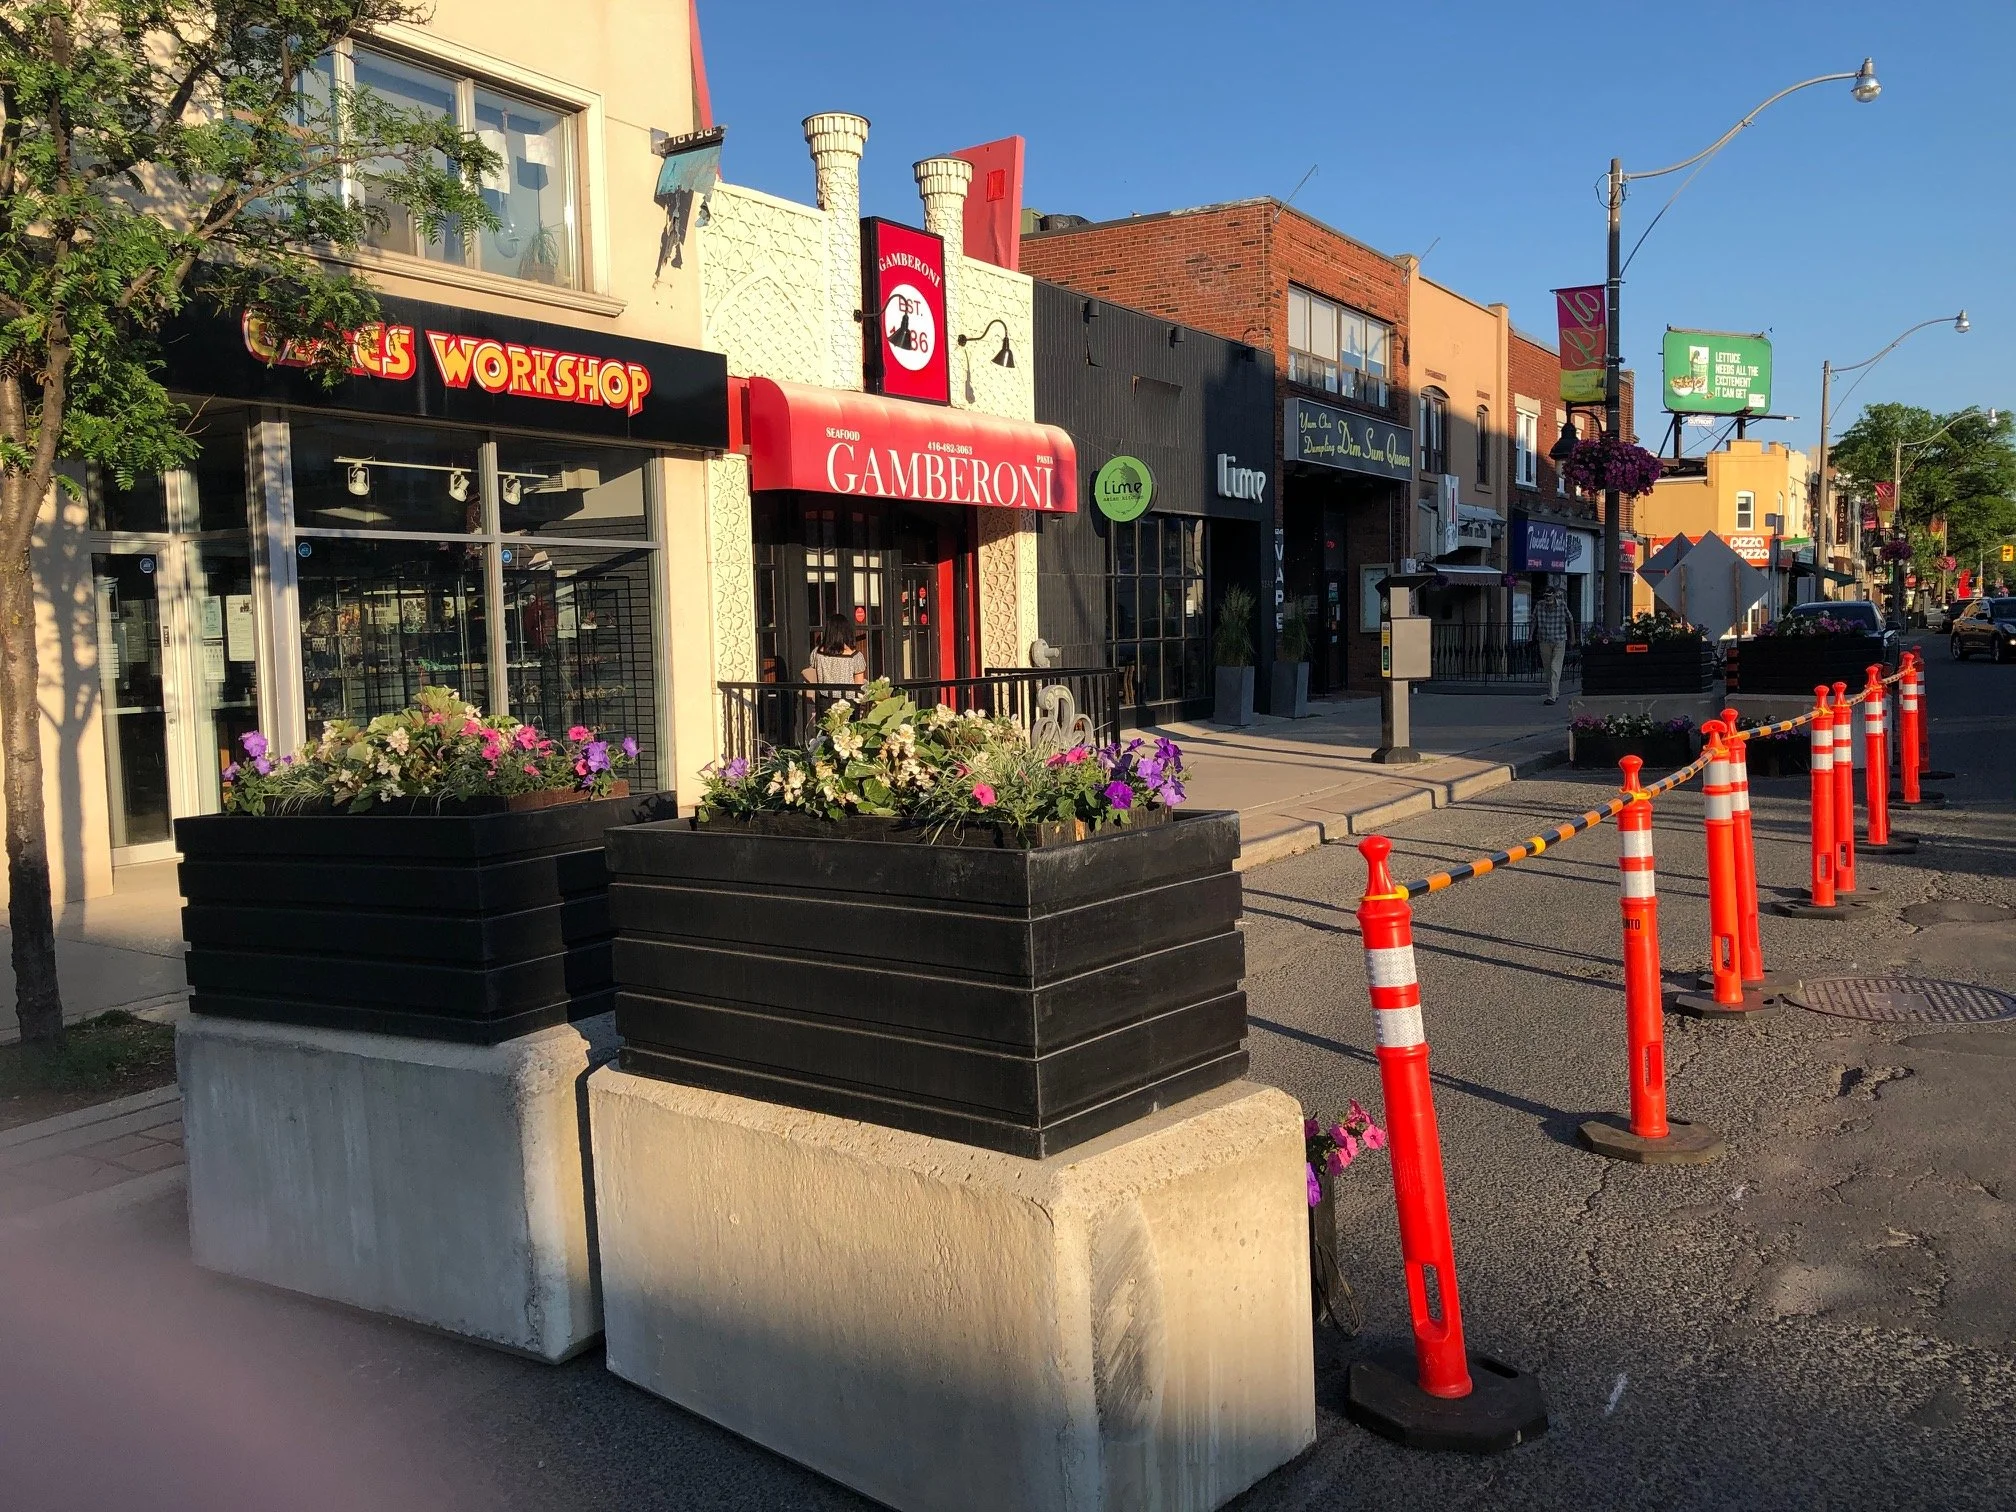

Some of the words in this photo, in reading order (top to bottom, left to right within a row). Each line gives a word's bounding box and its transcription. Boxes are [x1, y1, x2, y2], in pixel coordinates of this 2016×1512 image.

[879, 252, 941, 288] GAMBERONI
[898, 299, 923, 317] EST.
[890, 325, 929, 353] 86
[242, 304, 416, 381] GES
[426, 329, 652, 417] WORKSHOP
[1715, 352, 1741, 363] LETTUCE
[1715, 364, 1734, 375] NEEDS
[1736, 365, 1747, 375] ALL
[1748, 366, 1759, 376] THE
[1715, 375, 1751, 387] EXCITEMENT
[1714, 387, 1721, 397] IT
[1722, 388, 1735, 397] CAN
[1735, 388, 1747, 399] GET
[826, 427, 860, 441] SEAFOOD
[1337, 420, 1361, 457] Dim
[1363, 427, 1384, 462] Sum
[1386, 432, 1411, 469] Queen
[1036, 454, 1054, 465] PASTA
[826, 442, 1055, 509] GAMBERONI
[1730, 536, 1764, 549] pizza
[1275, 543, 1284, 629] VAPE
